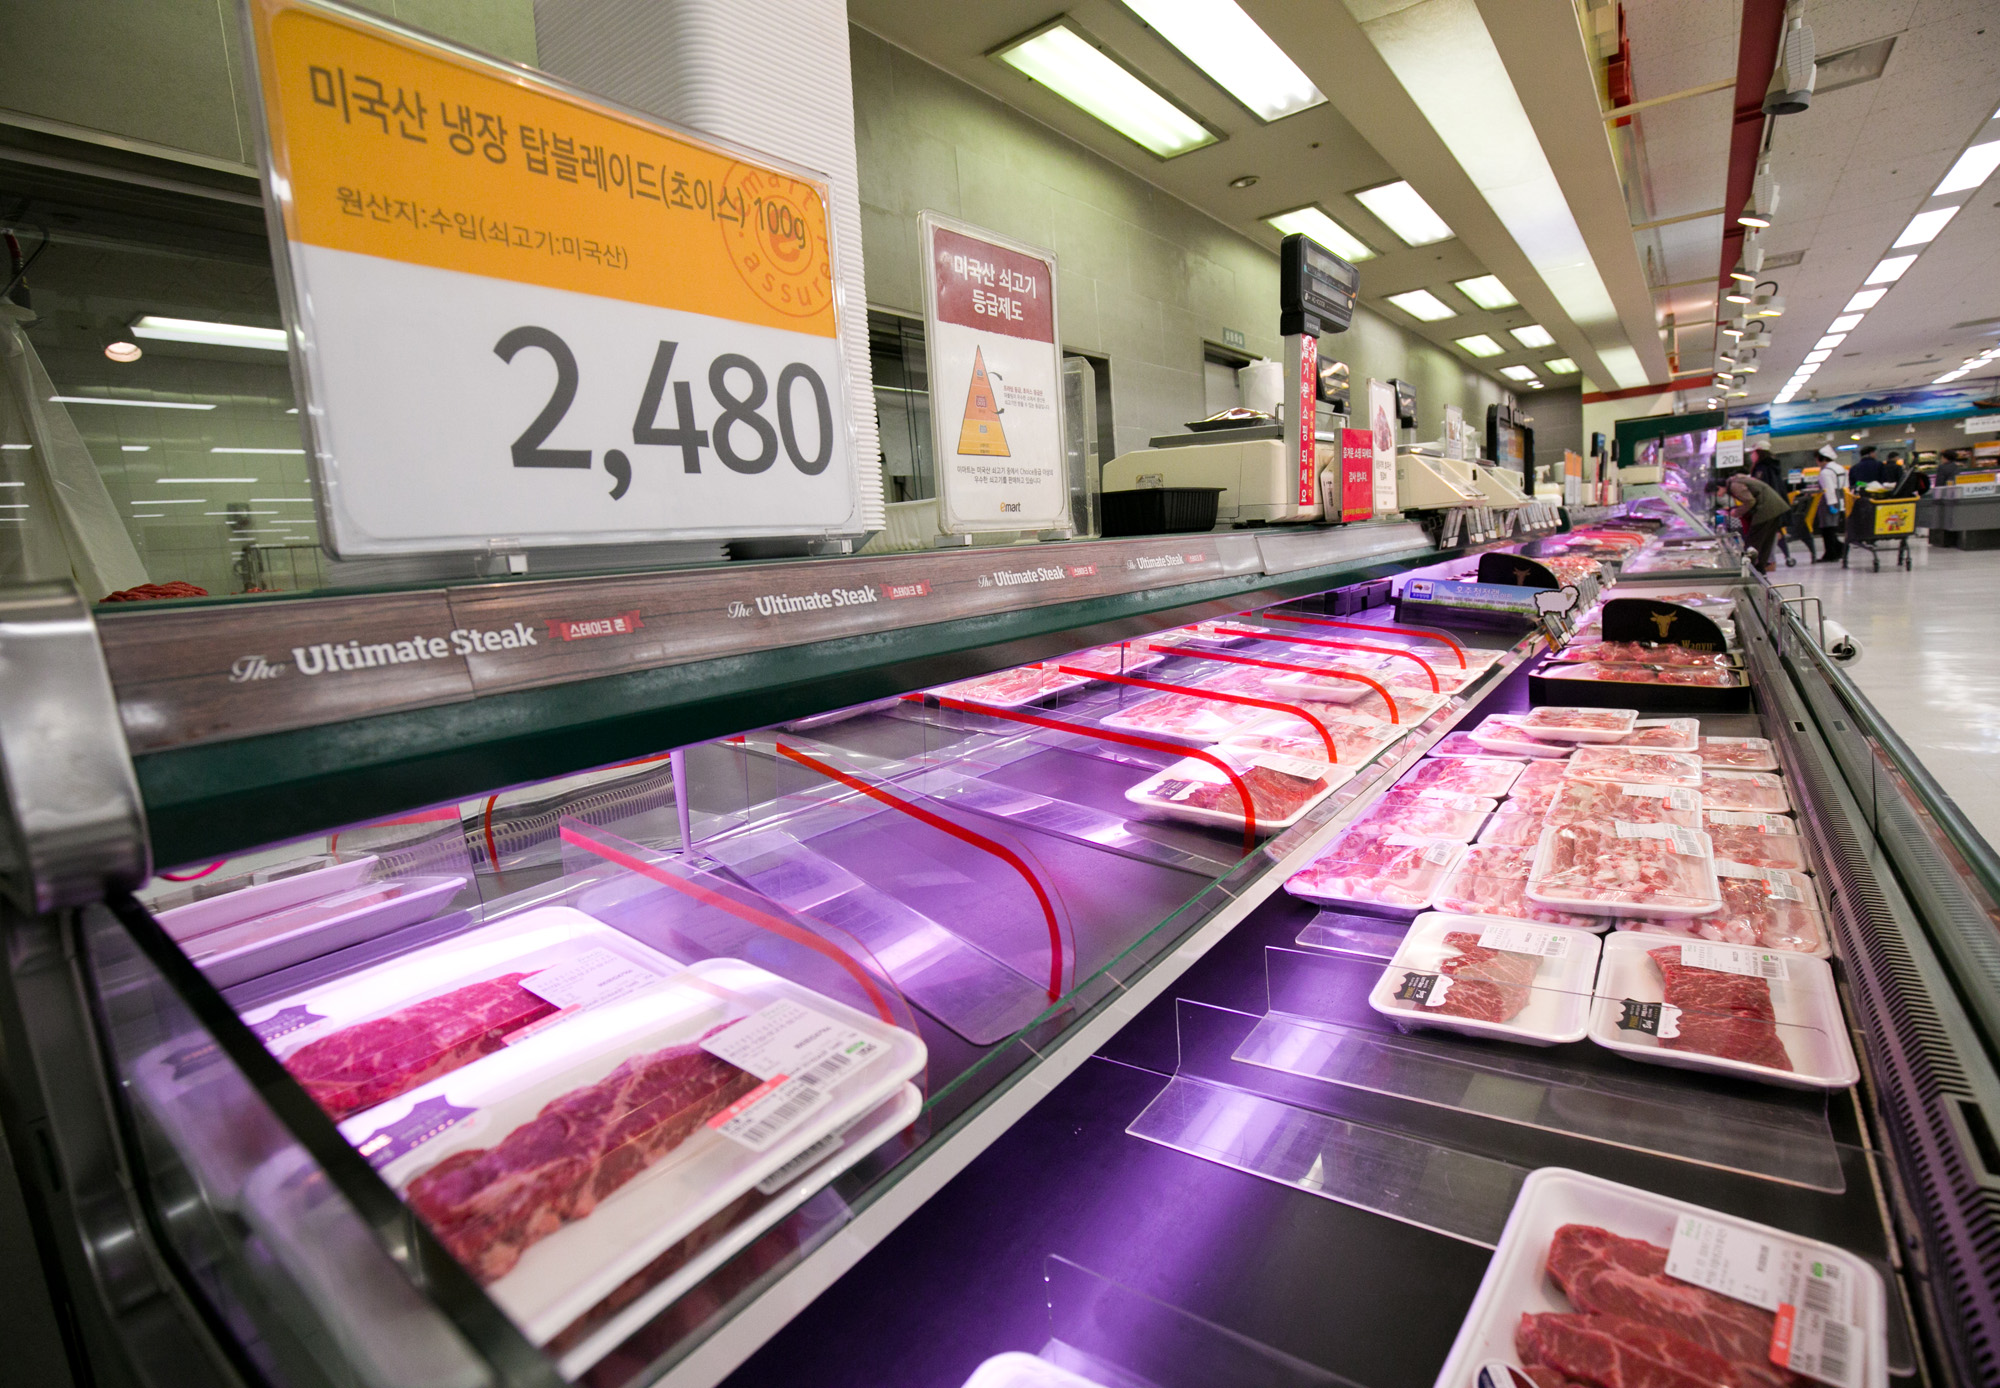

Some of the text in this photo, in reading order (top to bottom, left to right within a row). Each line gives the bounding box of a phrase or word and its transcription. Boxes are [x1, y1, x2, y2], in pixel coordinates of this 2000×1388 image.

[309, 64, 807, 250] 미국산 냉장 탑블레이드(초이스) 100g
[336, 185, 629, 270] 원산지:수입(쇠고기:미국산)
[953, 255, 1037, 299] 미국산 쇠고기
[972, 289, 1024, 321] 등급제도
[493, 325, 834, 501] 2,480
[1301, 406, 1309, 441] 쇼핑
[1300, 450, 1308, 502] 되세요
[1000, 502, 1021, 513] emart
[978, 574, 993, 588] The
[993, 570, 1039, 586] Ultimate
[1037, 565, 1065, 582] Steak
[1126, 559, 1137, 570] The
[1136, 555, 1167, 570] Ultimate
[1165, 553, 1185, 567] Steak
[727, 601, 753, 619] The
[755, 592, 832, 616] Ultimate
[832, 585, 877, 607] Steak
[893, 587, 915, 598] 스테이크
[229, 618, 627, 684] The Ultimate Steak 스테이크 존
